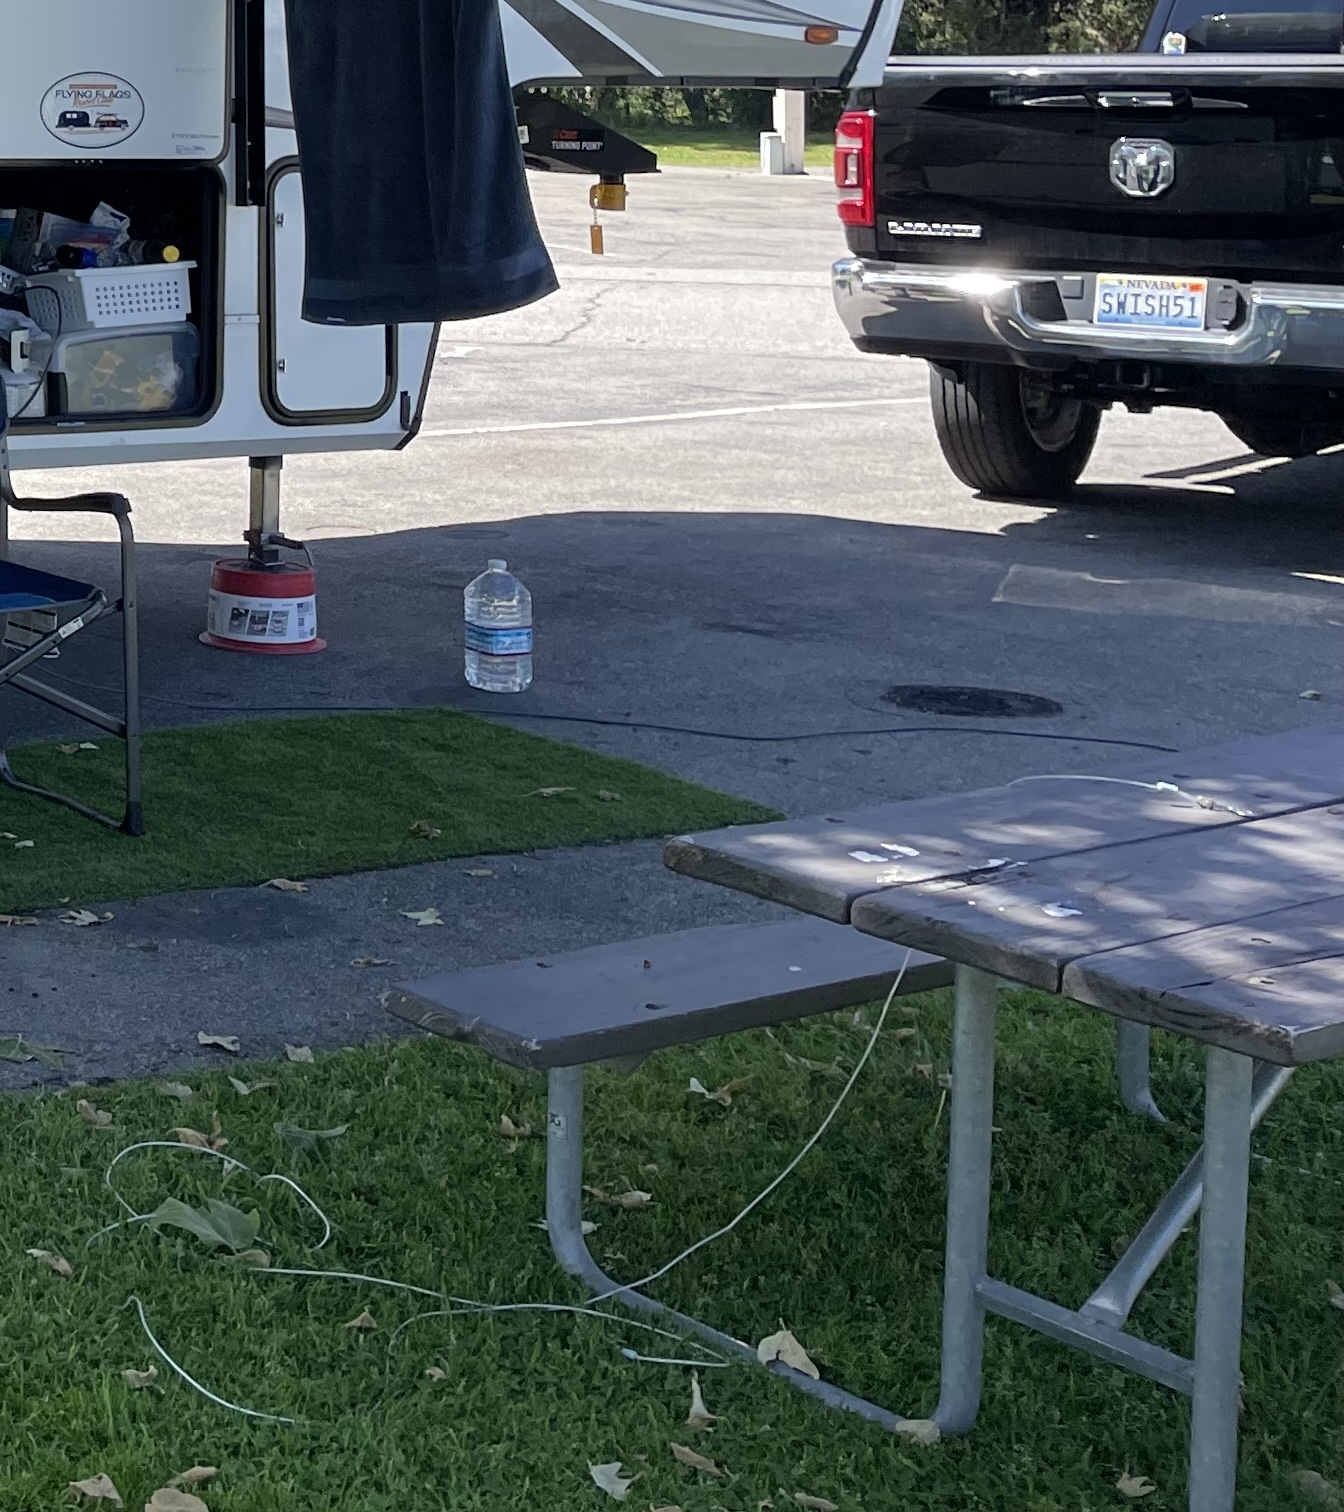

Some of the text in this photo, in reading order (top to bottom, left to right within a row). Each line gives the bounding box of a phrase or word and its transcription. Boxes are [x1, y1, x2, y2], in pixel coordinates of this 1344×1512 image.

[55, 90, 131, 99] FLYING FLAGS
[1126, 279, 1178, 290] NEVADA
[1102, 292, 1198, 319] SWISH51
